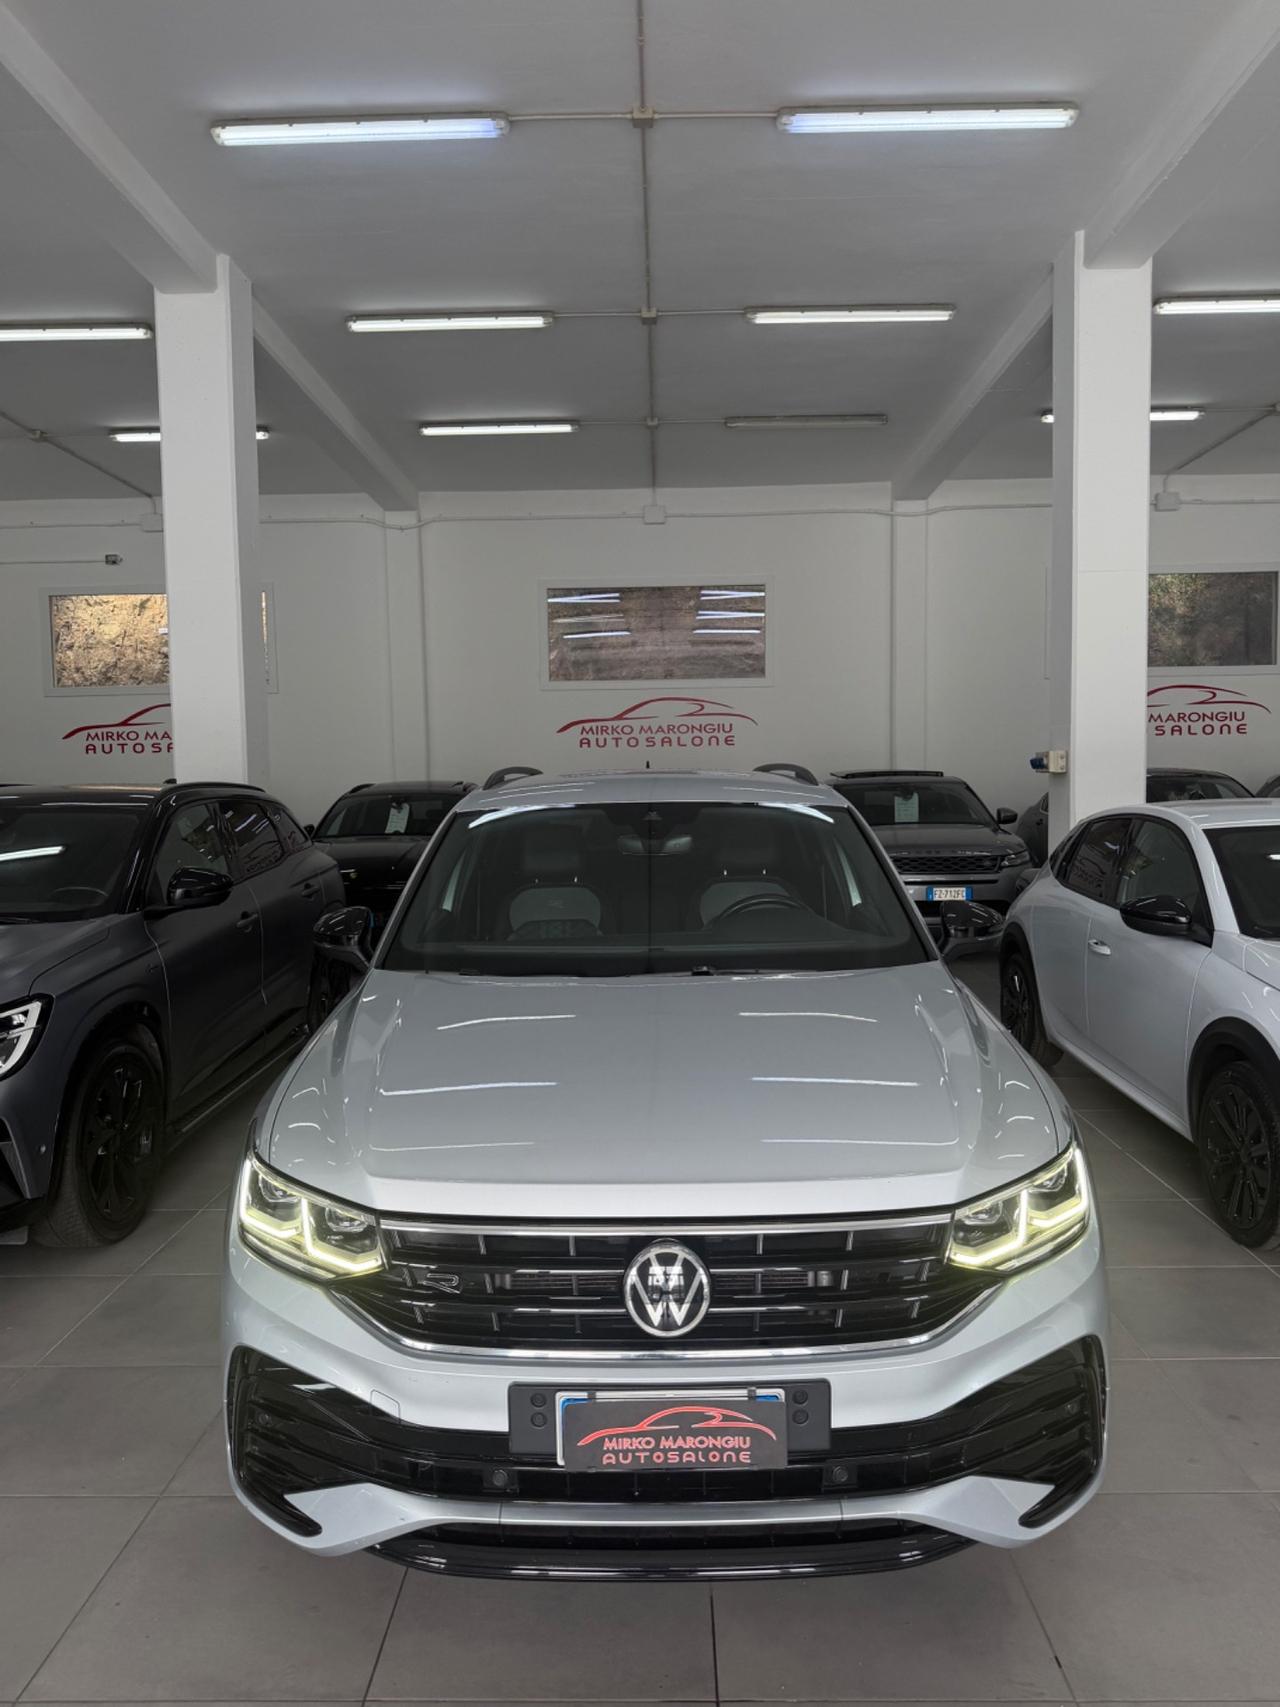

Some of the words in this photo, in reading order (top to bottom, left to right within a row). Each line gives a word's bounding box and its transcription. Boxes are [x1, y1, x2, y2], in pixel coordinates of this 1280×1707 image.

[1148, 711, 1245, 723] MARONGIU
[580, 725, 634, 735] MIRKO
[639, 723, 733, 735] MARONGIU
[86, 731, 139, 741] MIRKO
[579, 735, 735, 748] AUTOSALONE
[603, 1436, 655, 1450] MIRKO
[660, 1435, 751, 1449] MARONGIU
[602, 1451, 751, 1465] AUTOSALONE
